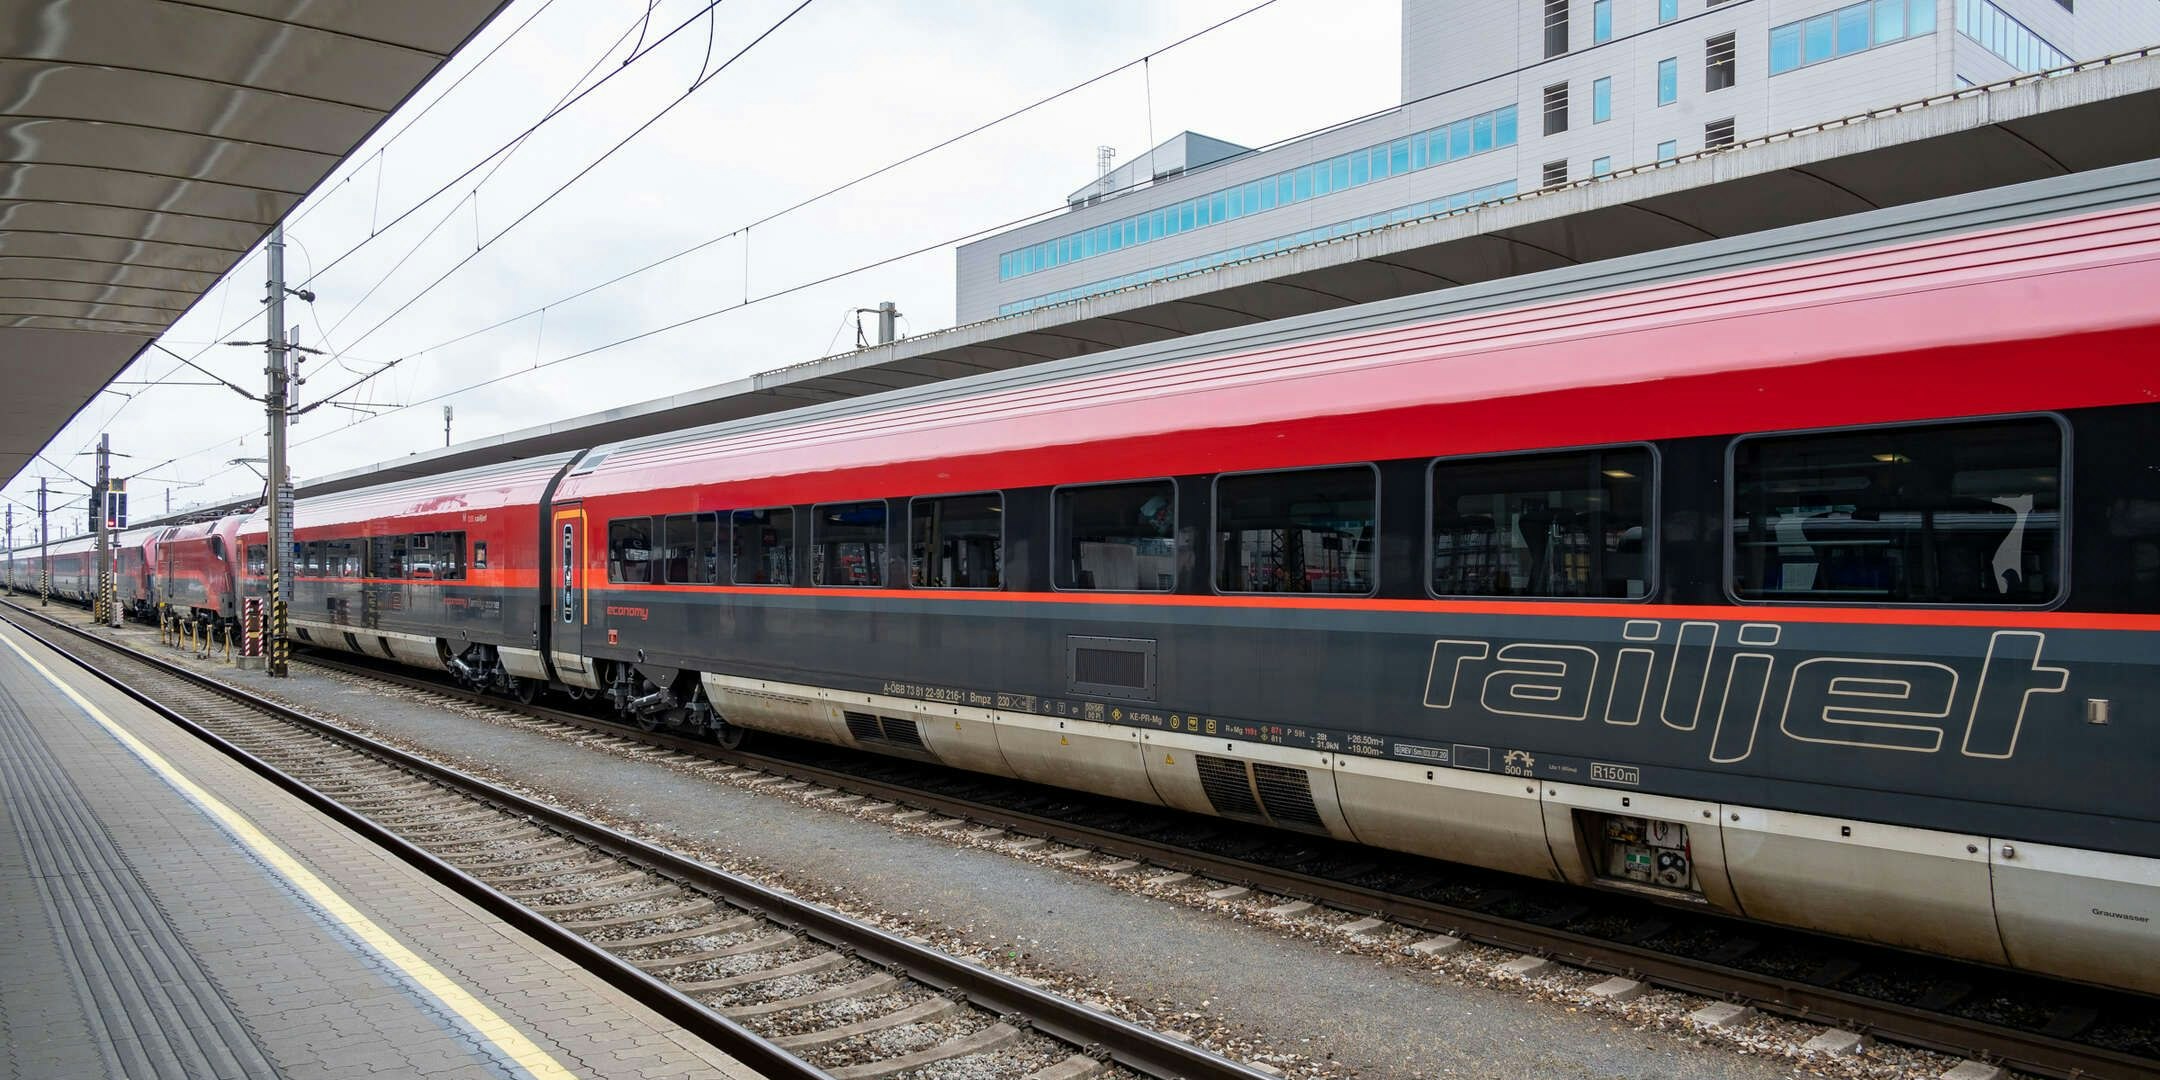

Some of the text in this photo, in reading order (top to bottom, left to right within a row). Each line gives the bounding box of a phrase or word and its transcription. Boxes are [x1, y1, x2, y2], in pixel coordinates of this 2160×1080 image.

[565, 533, 571, 549] 2
[607, 606, 648, 620] economy
[883, 681, 906, 694] A-ÖBB
[907, 685, 916, 696] 73
[925, 688, 945, 699] 22-90
[946, 690, 966, 702] 216-1
[970, 692, 992, 705] Bmpz
[1423, 619, 2070, 764] railjet
[1130, 712, 1162, 726] KE-PR-Mg
[1504, 765, 1521, 776] 500
[1593, 766, 1637, 782] R150m
[2092, 908, 2150, 923] Grauwasser
